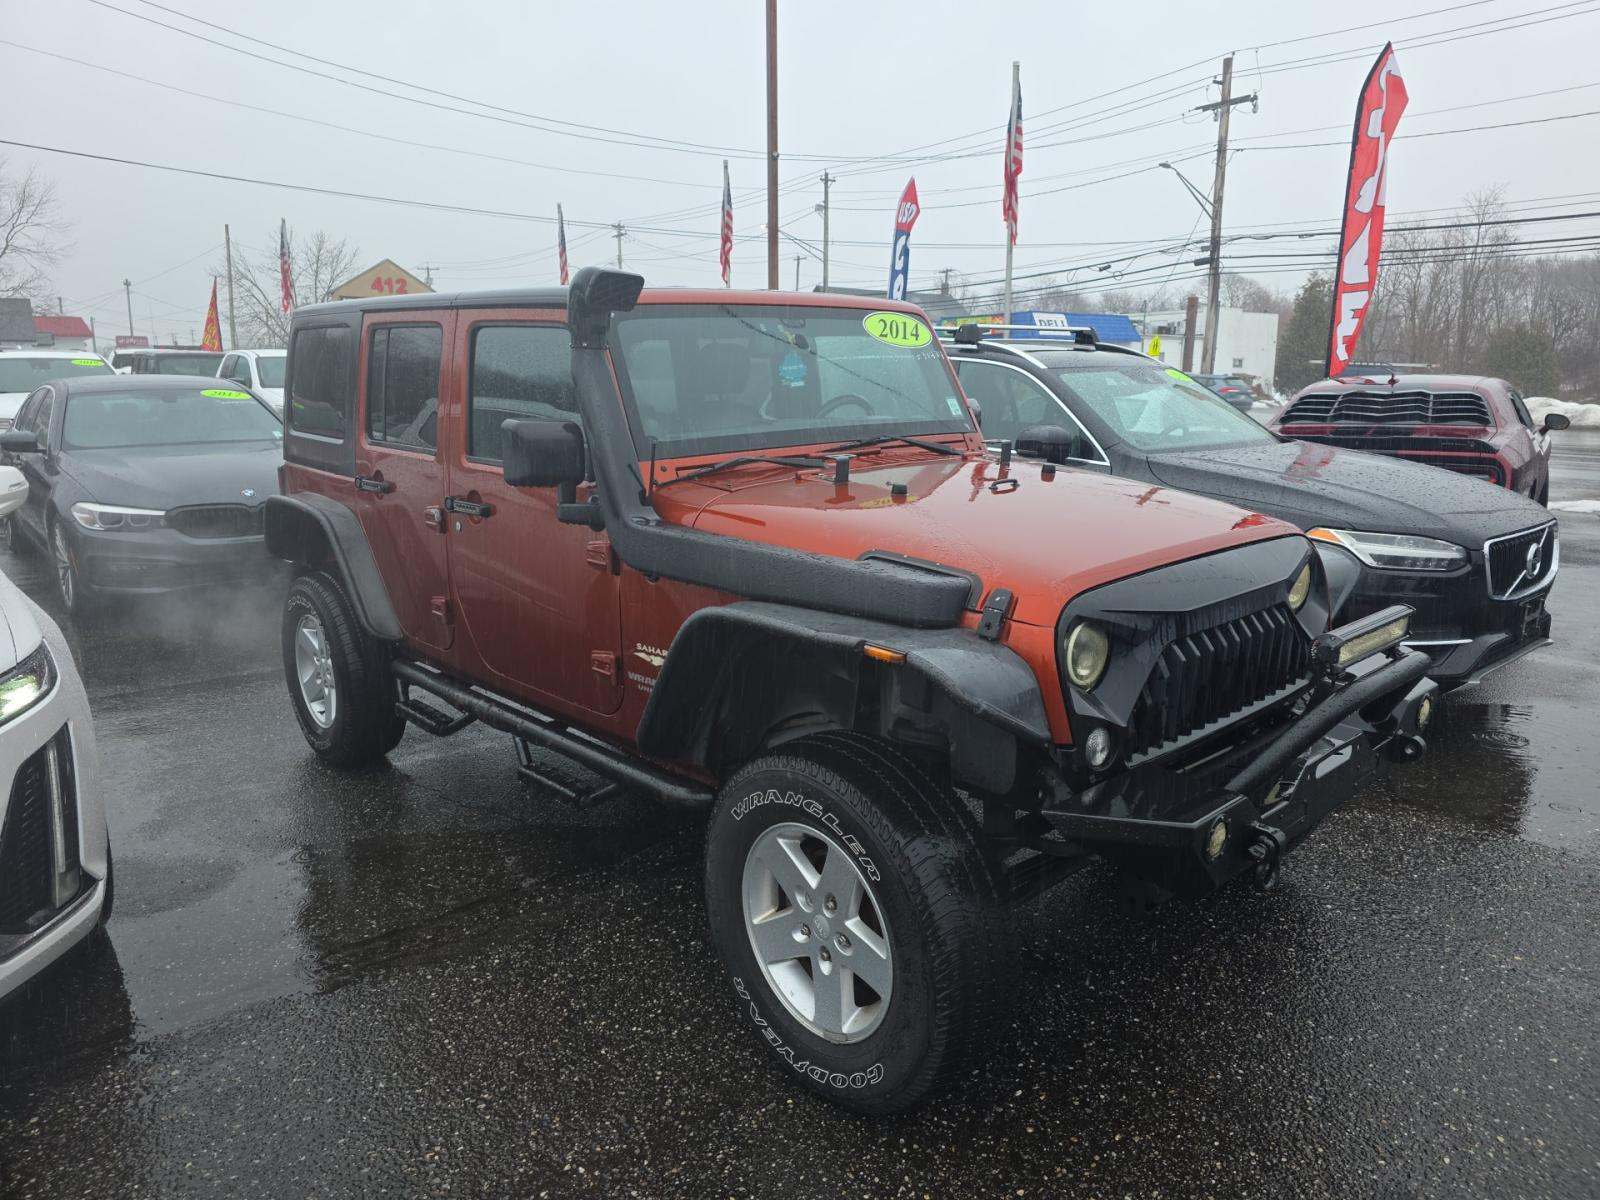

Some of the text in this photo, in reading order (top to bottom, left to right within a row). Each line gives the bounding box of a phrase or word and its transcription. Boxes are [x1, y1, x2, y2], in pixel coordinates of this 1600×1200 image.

[371, 276, 408, 294] 412
[878, 318, 920, 341] 2014
[636, 643, 669, 656] SAHAR
[627, 671, 657, 686] WRAN
[730, 789, 881, 882] WRANGLER
[733, 976, 884, 1089] GOODYEAR
